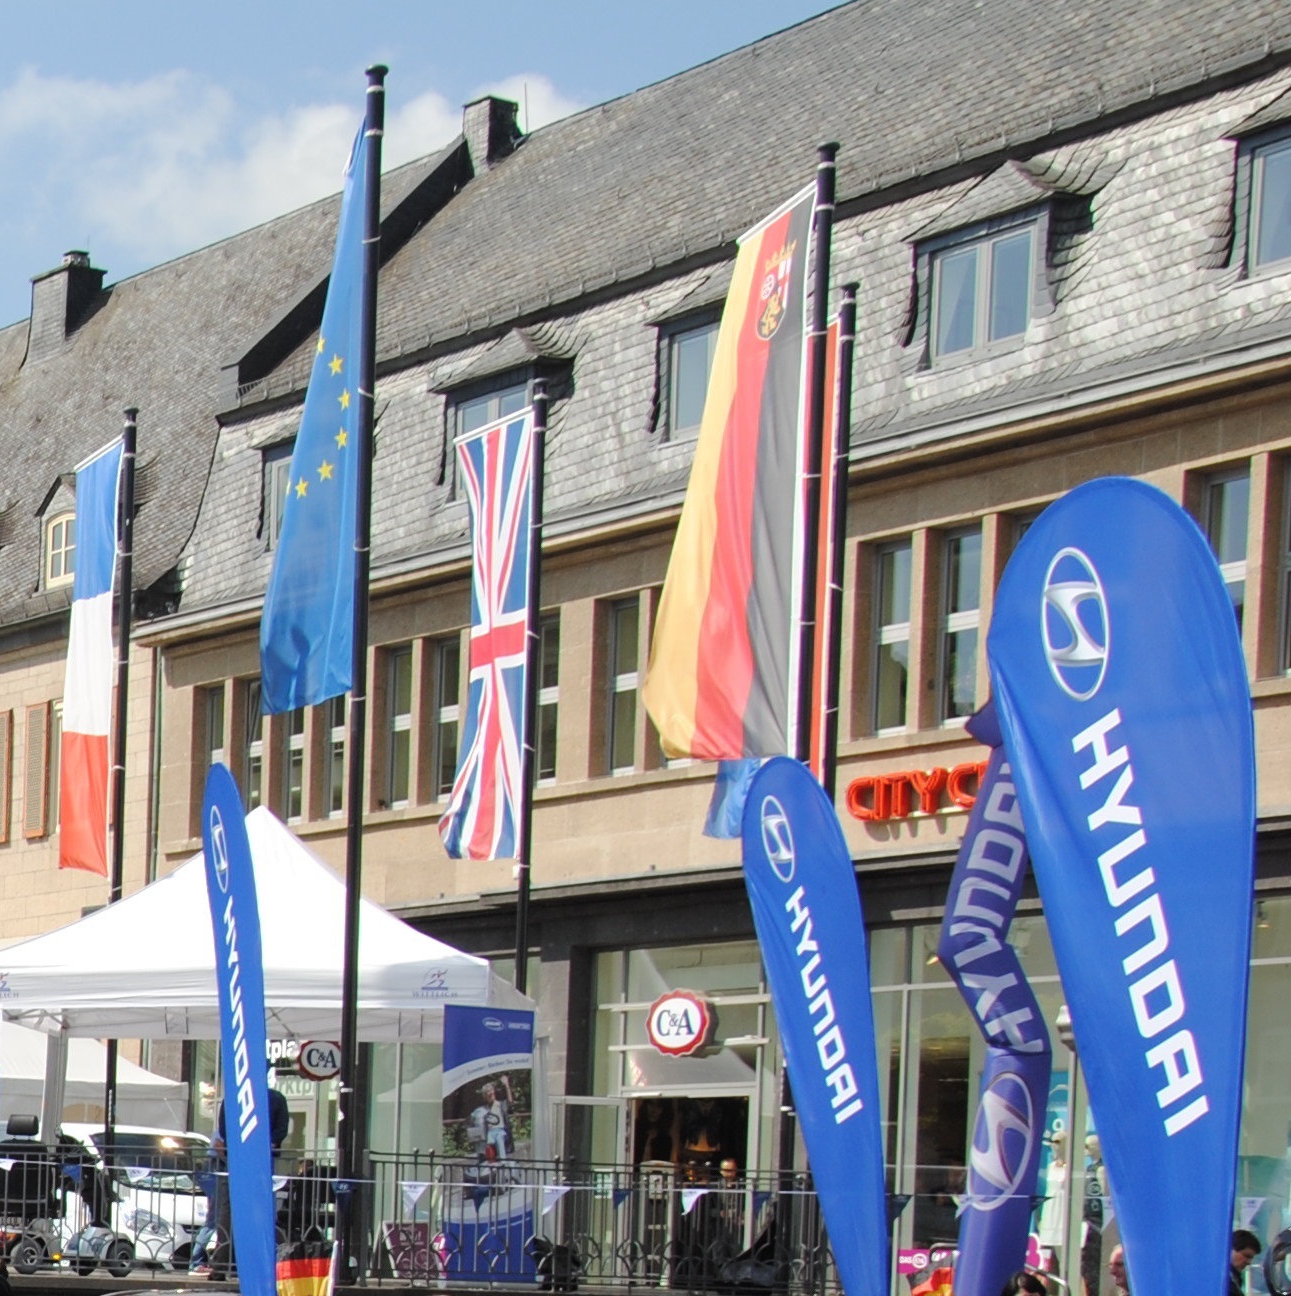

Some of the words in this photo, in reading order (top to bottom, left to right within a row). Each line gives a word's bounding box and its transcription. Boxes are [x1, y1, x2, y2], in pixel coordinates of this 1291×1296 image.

[223, 895, 259, 1144] HYUNDAI
[655, 1007, 694, 1039] C&A
[785, 886, 863, 1125] HYUNDAI
[1071, 708, 1210, 1138] HYUNDAI
[306, 1048, 337, 1068] C&A
